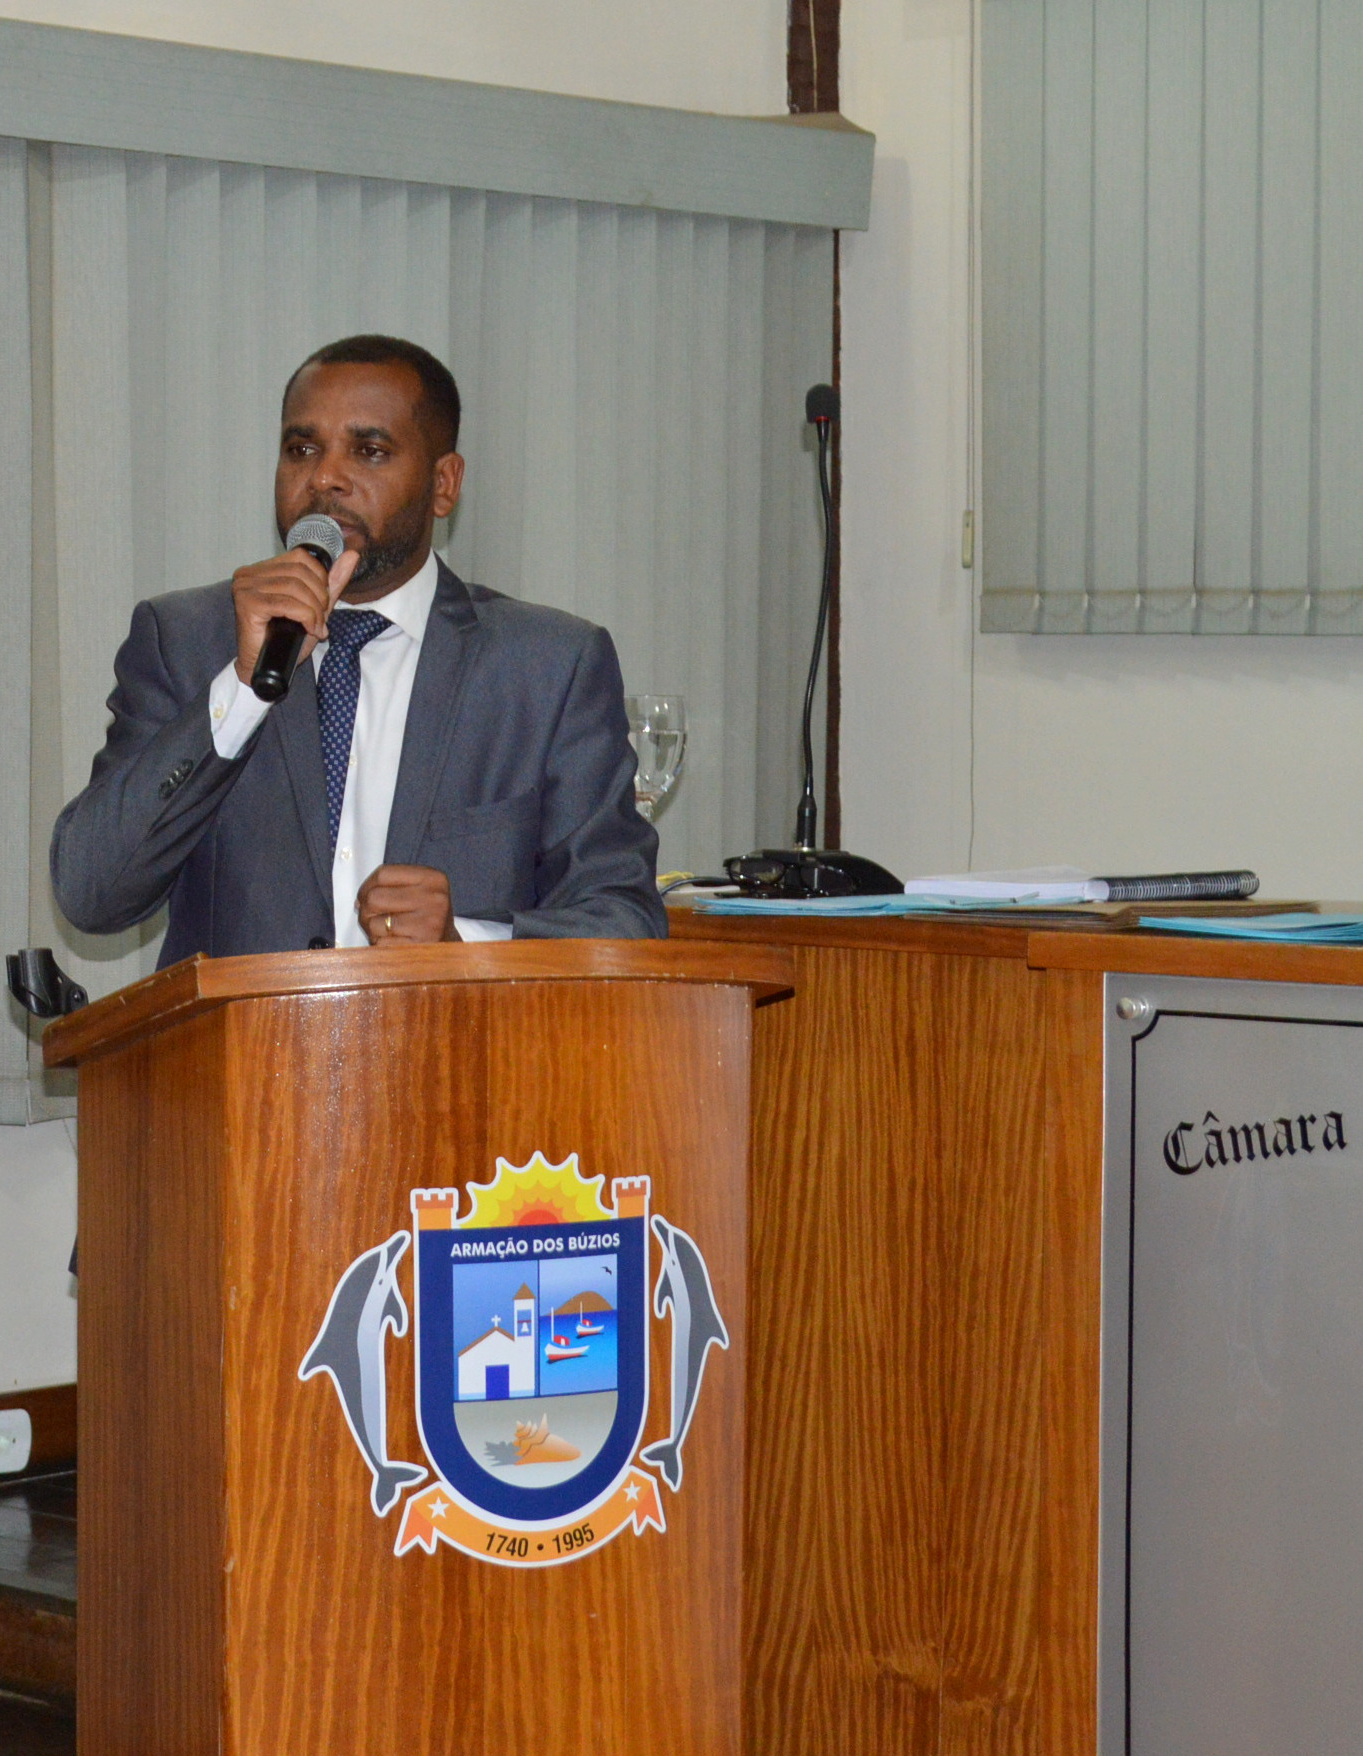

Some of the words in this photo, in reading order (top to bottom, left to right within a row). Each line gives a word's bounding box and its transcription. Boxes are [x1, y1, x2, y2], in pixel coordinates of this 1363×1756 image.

[1163, 1110, 1348, 1176] Câmara
[450, 1237, 529, 1259] ARMAÇÃO
[532, 1237, 564, 1254] DOS
[568, 1231, 621, 1251] BÚZIOS
[485, 1531, 529, 1558] 1740
[552, 1522, 595, 1554] 1995
